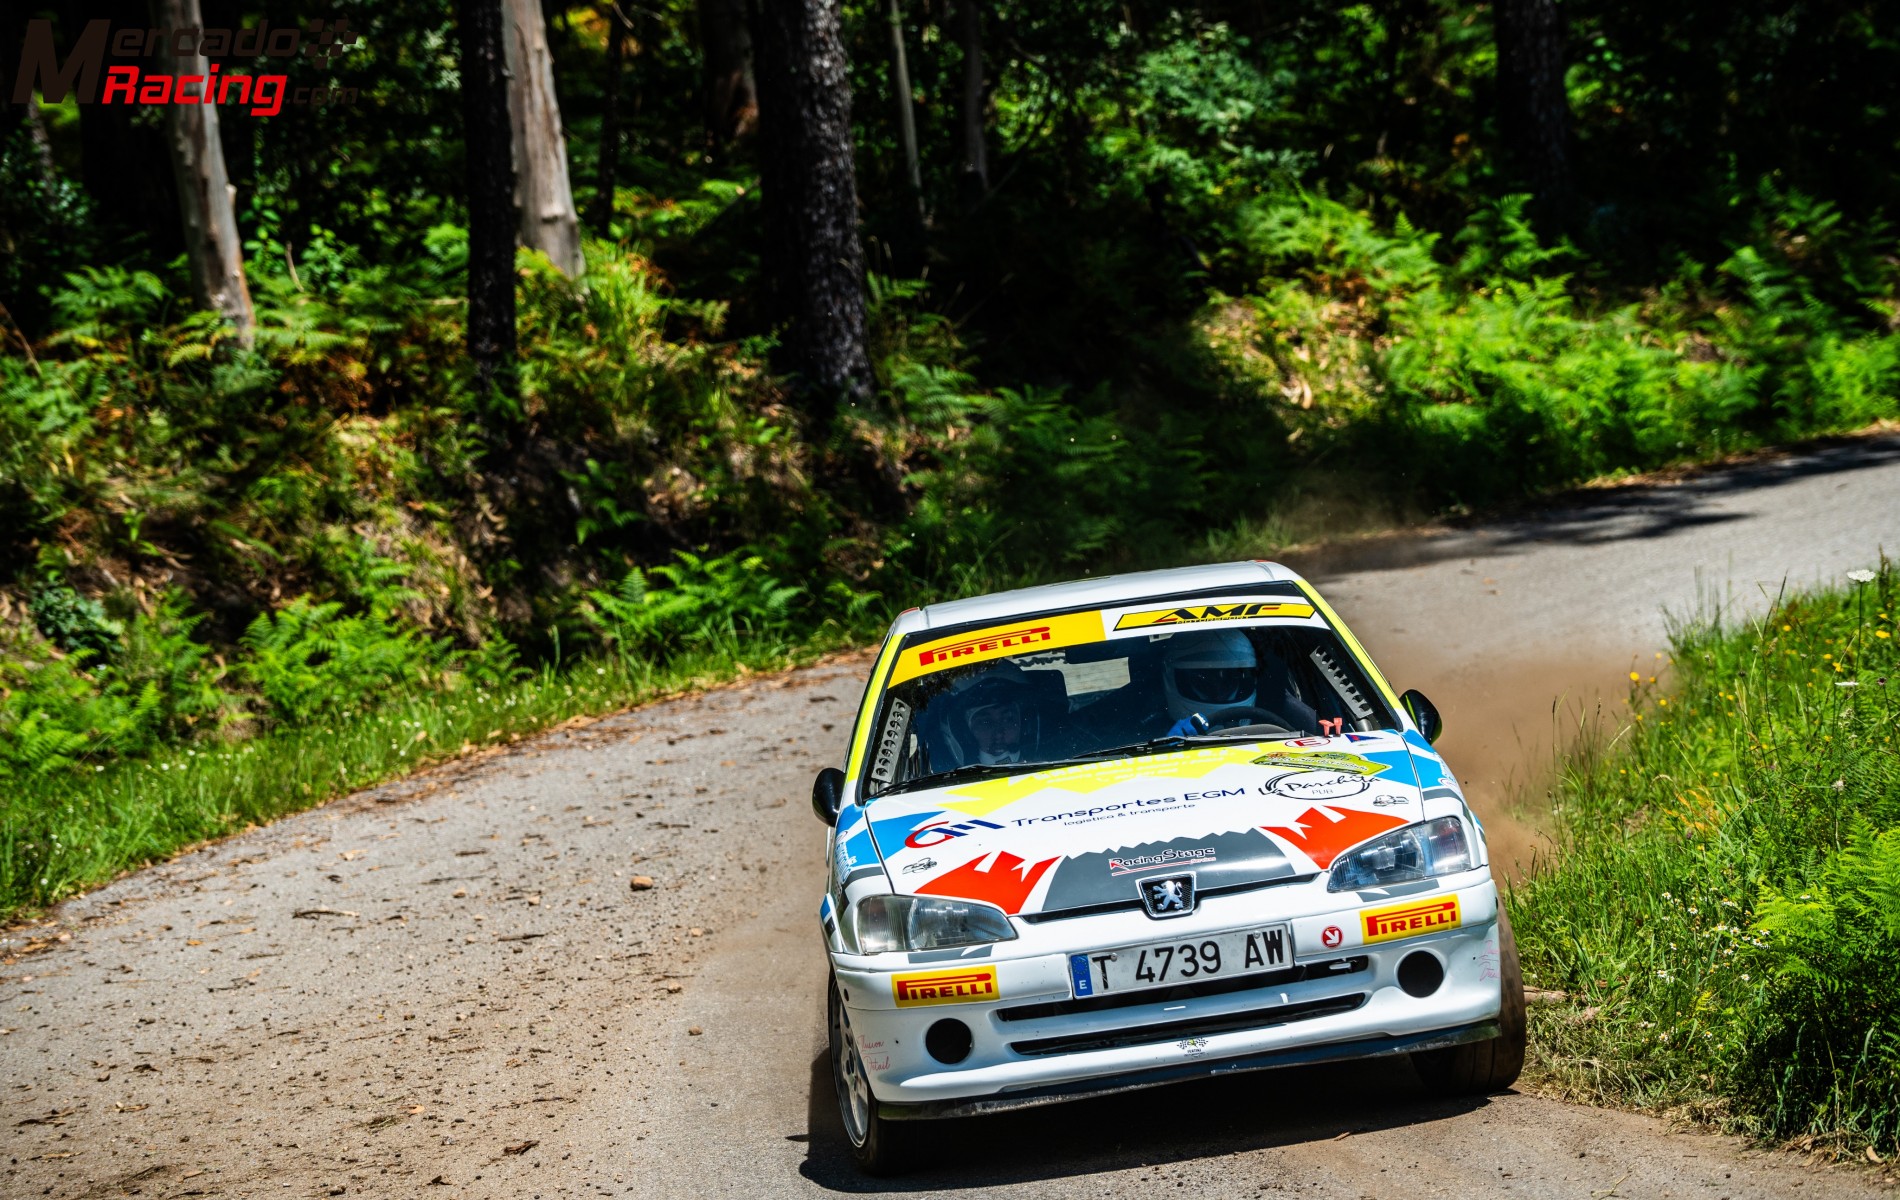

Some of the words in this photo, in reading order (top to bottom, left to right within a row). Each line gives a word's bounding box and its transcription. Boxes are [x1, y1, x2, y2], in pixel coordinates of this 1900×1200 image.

[1151, 603, 1282, 623] AMF
[919, 626, 1051, 666] PIRELLI
[1011, 796, 1177, 827] Transportes
[1184, 787, 1246, 801] EGM
[1312, 788, 1333, 796] PUB
[1130, 804, 1195, 816] transporte
[1366, 902, 1456, 936] PIRELLI
[1079, 980, 1087, 989] E
[1092, 954, 1114, 990] T
[1135, 940, 1221, 983] 4739
[1245, 929, 1284, 968] AW
[896, 973, 992, 1001] PIRELLI
